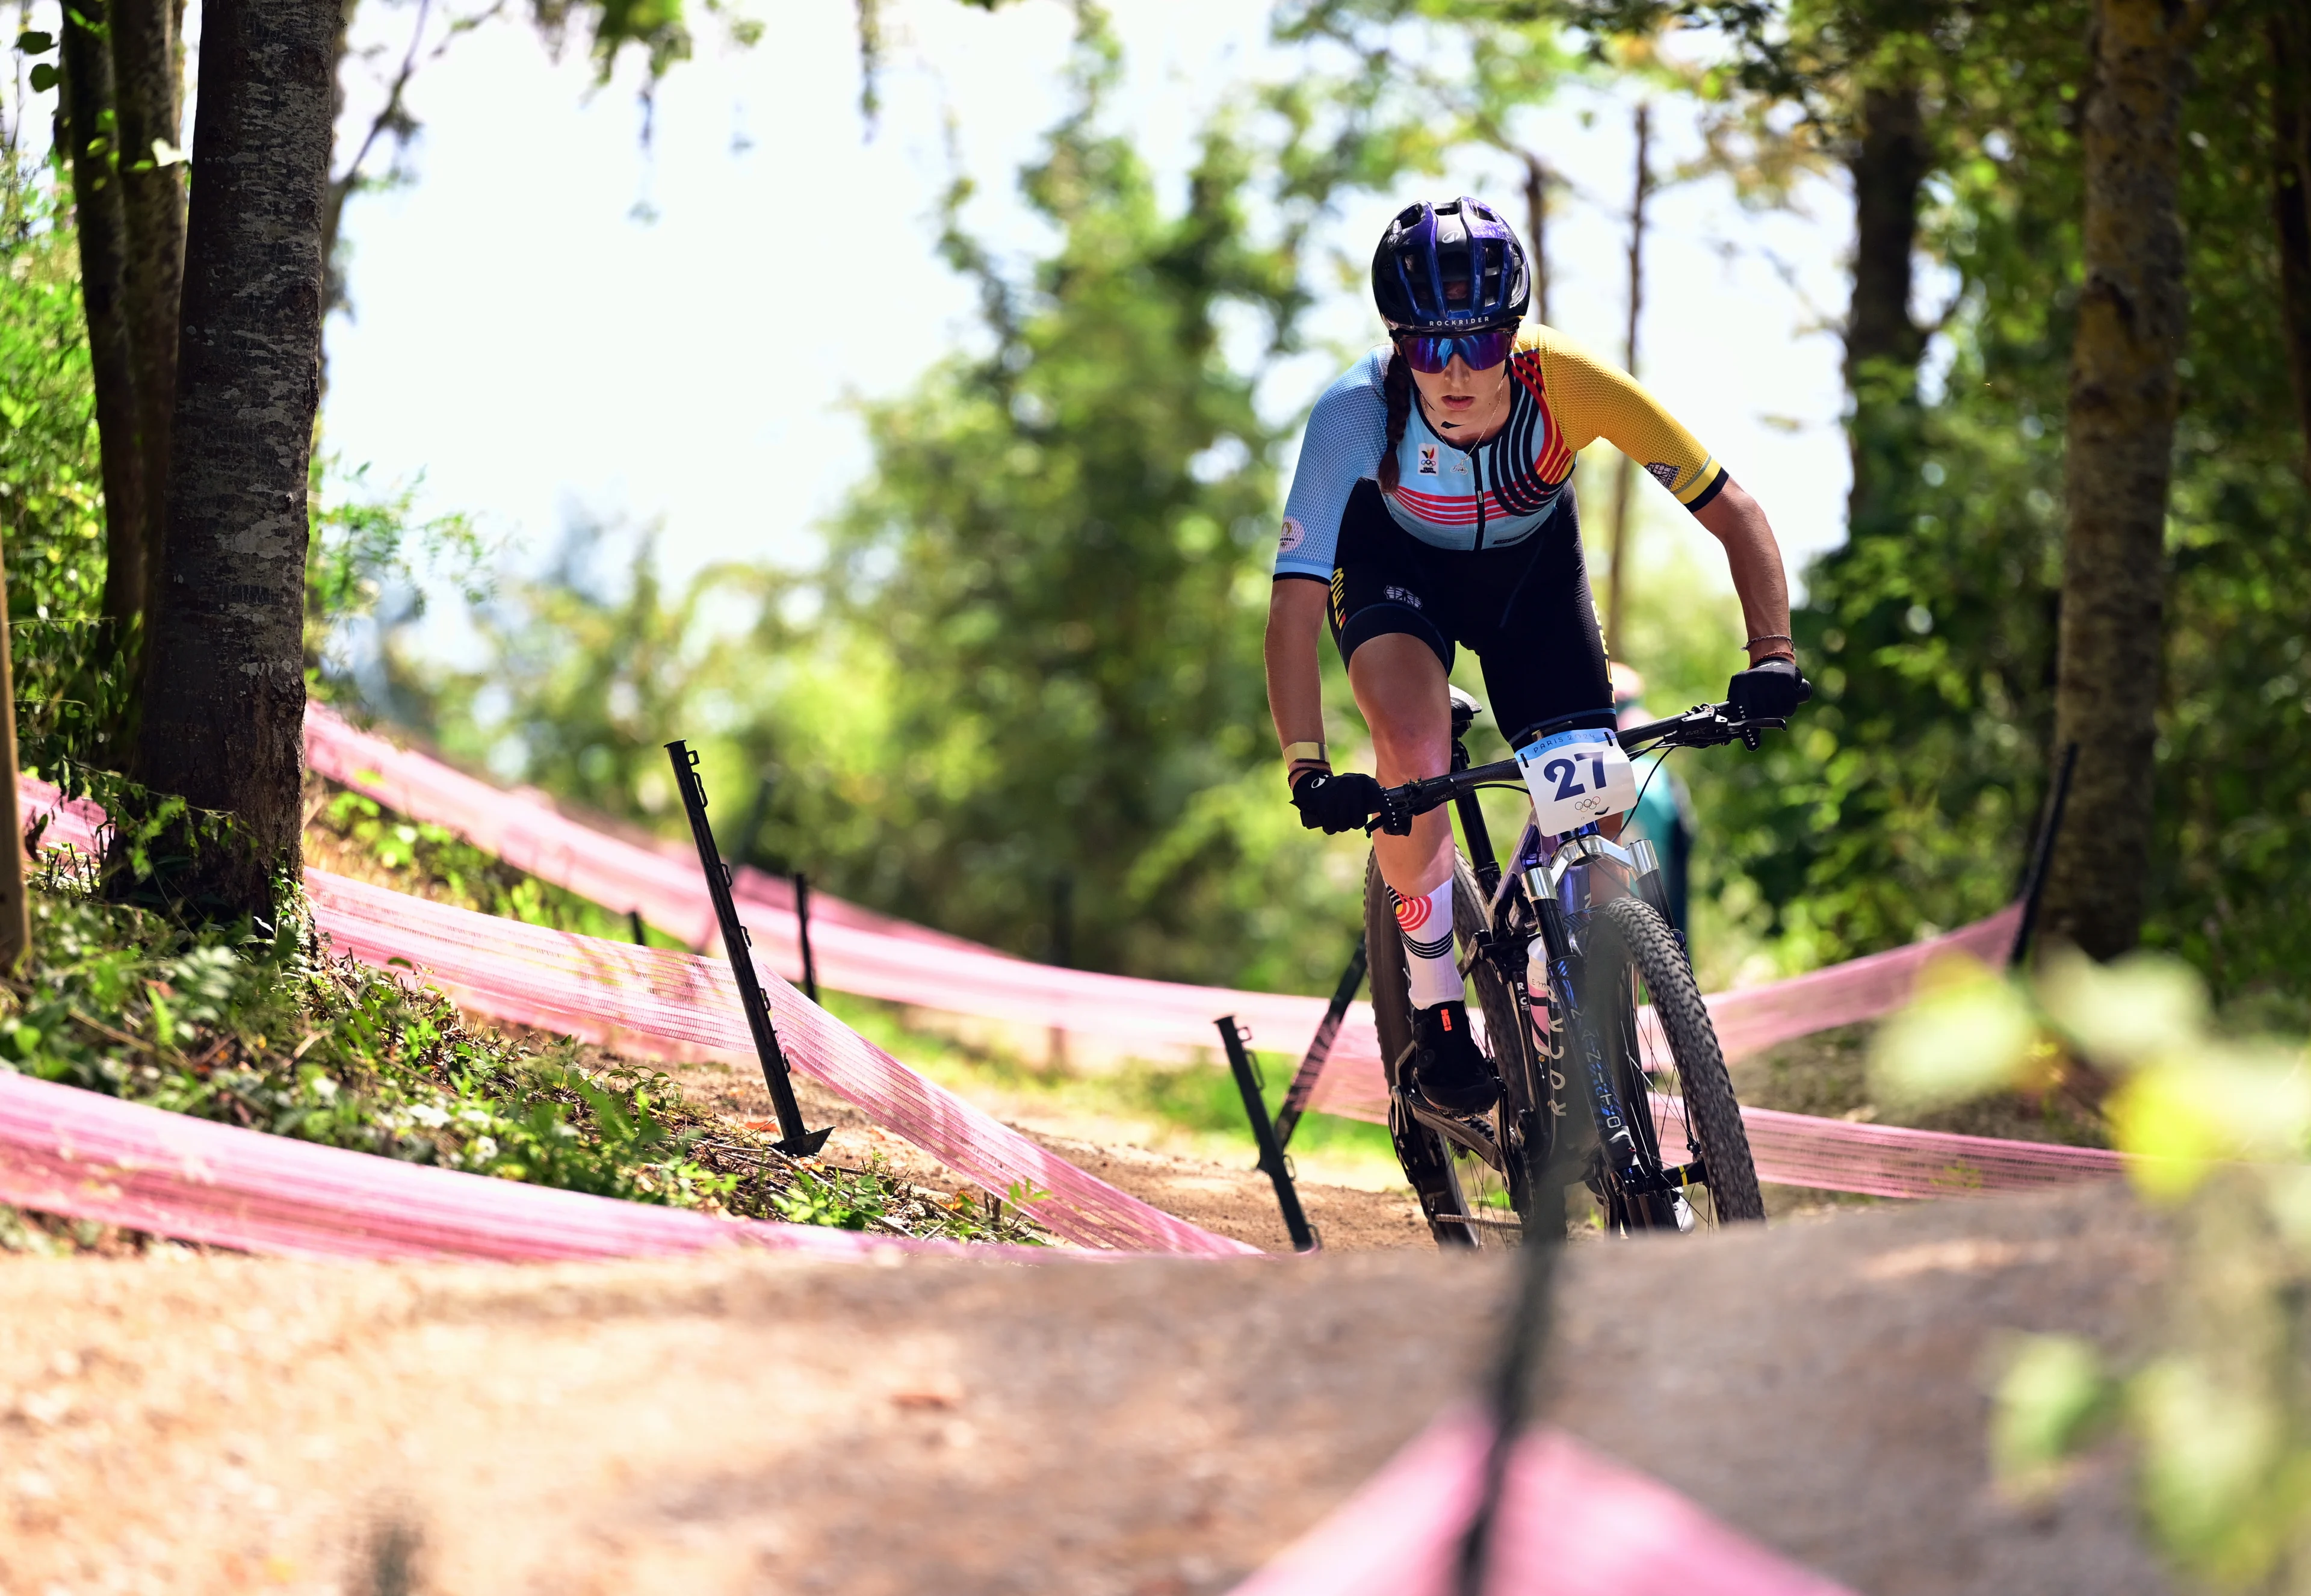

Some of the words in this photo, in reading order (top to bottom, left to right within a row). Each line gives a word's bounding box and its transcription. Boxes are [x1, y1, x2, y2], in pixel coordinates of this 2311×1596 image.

[1429, 316, 1489, 326] ROCKRIDER
[1533, 737, 1564, 753] PARIS
[1739, 705, 1756, 746] ROCKDER
[1543, 751, 1607, 802] 27
[1570, 1006, 1621, 1129] MANITO
